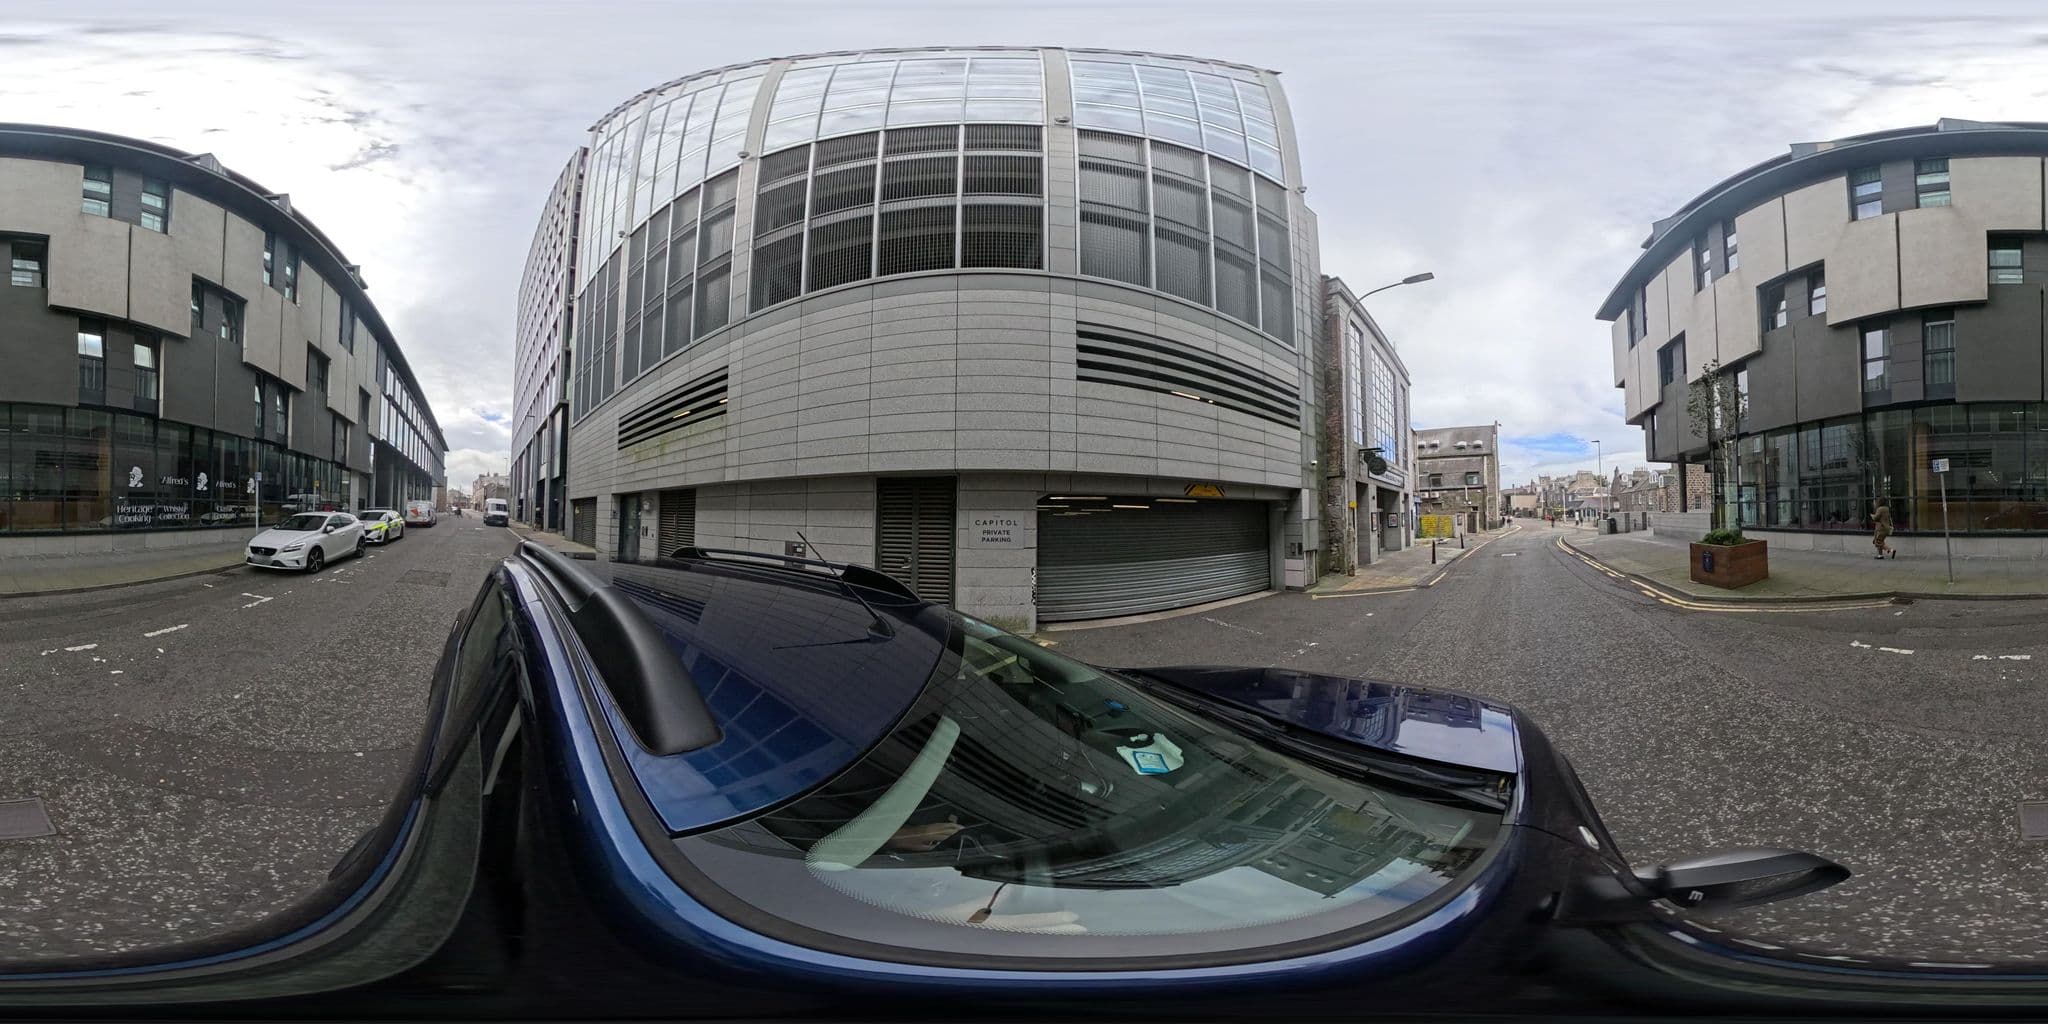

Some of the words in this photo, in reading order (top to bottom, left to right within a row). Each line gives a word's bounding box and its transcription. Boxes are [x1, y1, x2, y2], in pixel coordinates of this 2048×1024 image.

[161, 476, 189, 486] Alfred's
[117, 505, 153, 514] Heritage
[118, 514, 152, 523] Cooking
